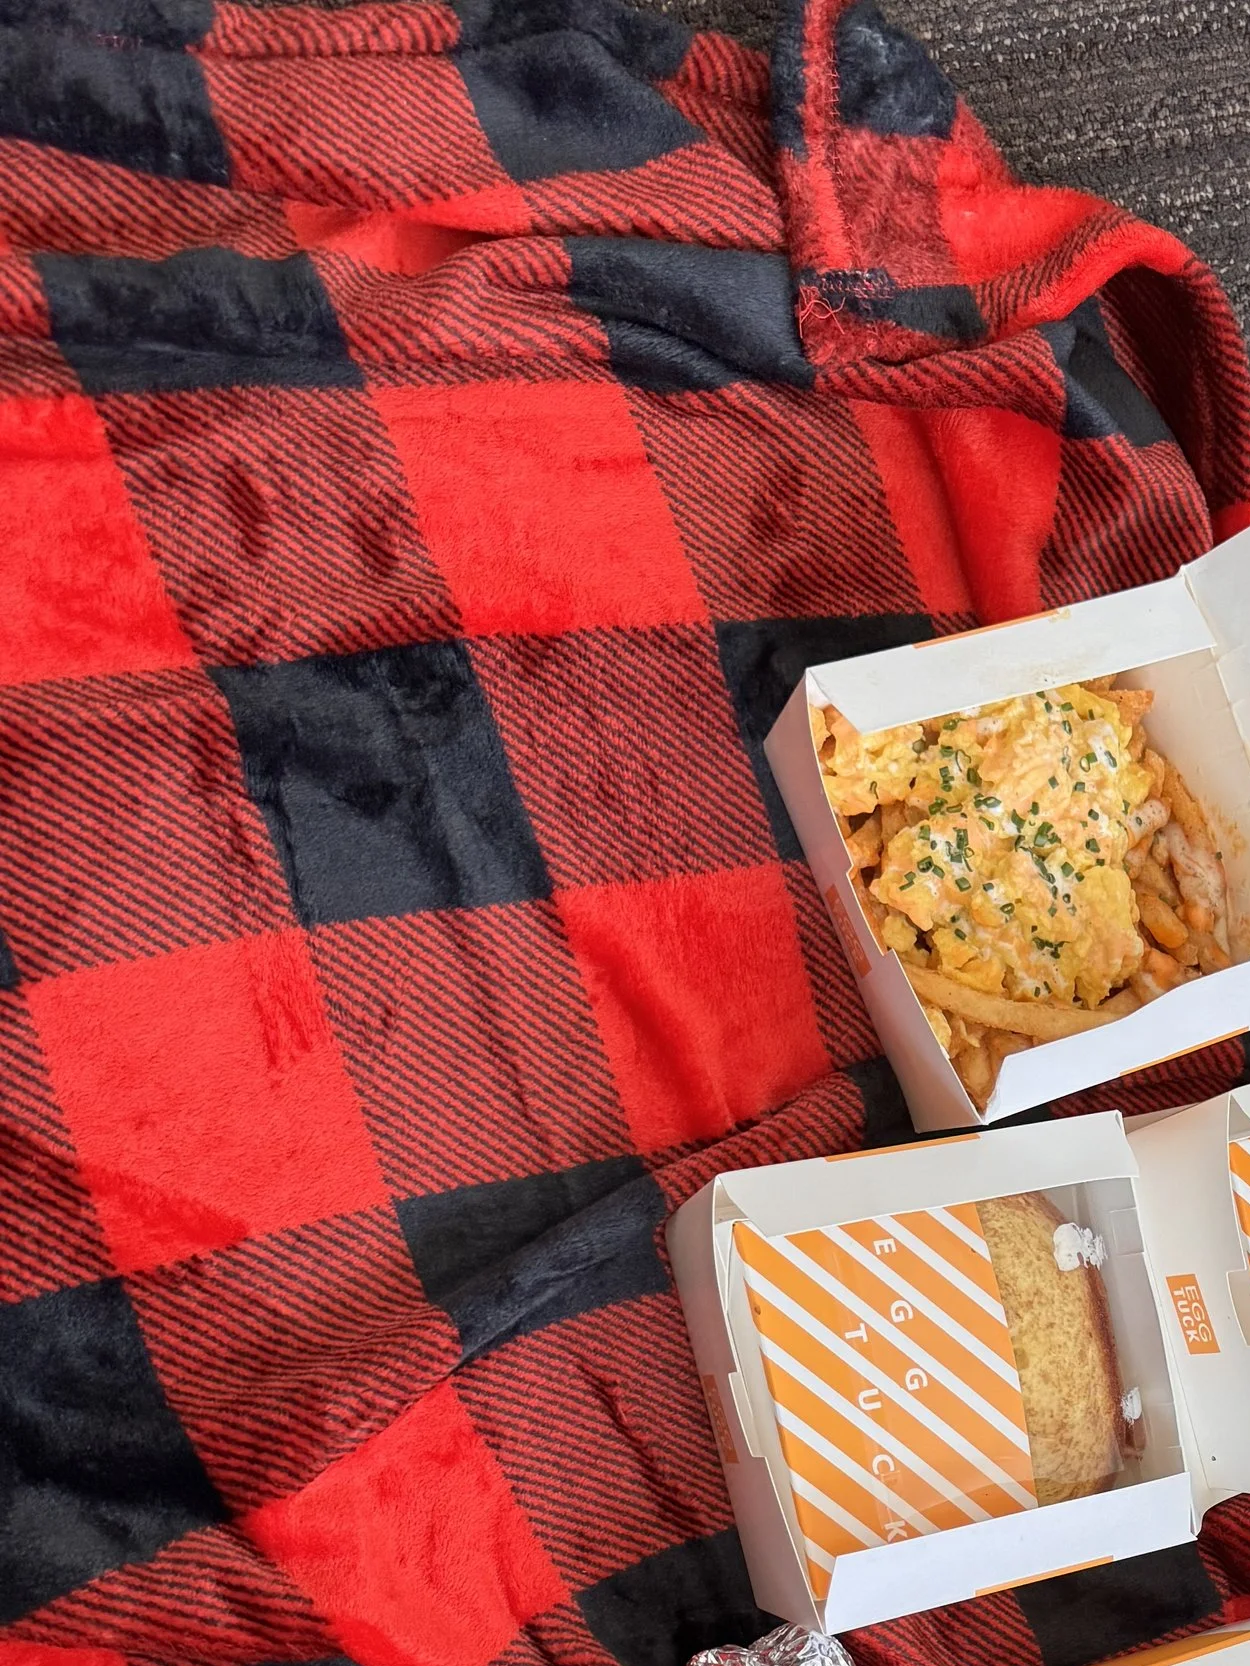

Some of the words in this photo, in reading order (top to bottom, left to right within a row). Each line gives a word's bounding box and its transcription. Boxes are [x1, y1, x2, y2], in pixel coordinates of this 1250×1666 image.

[873, 1238, 928, 1391] EGG
[1173, 1287, 1200, 1343] TUCK
[1184, 1285, 1212, 1342] EGG
[845, 1323, 908, 1543] TUCK
